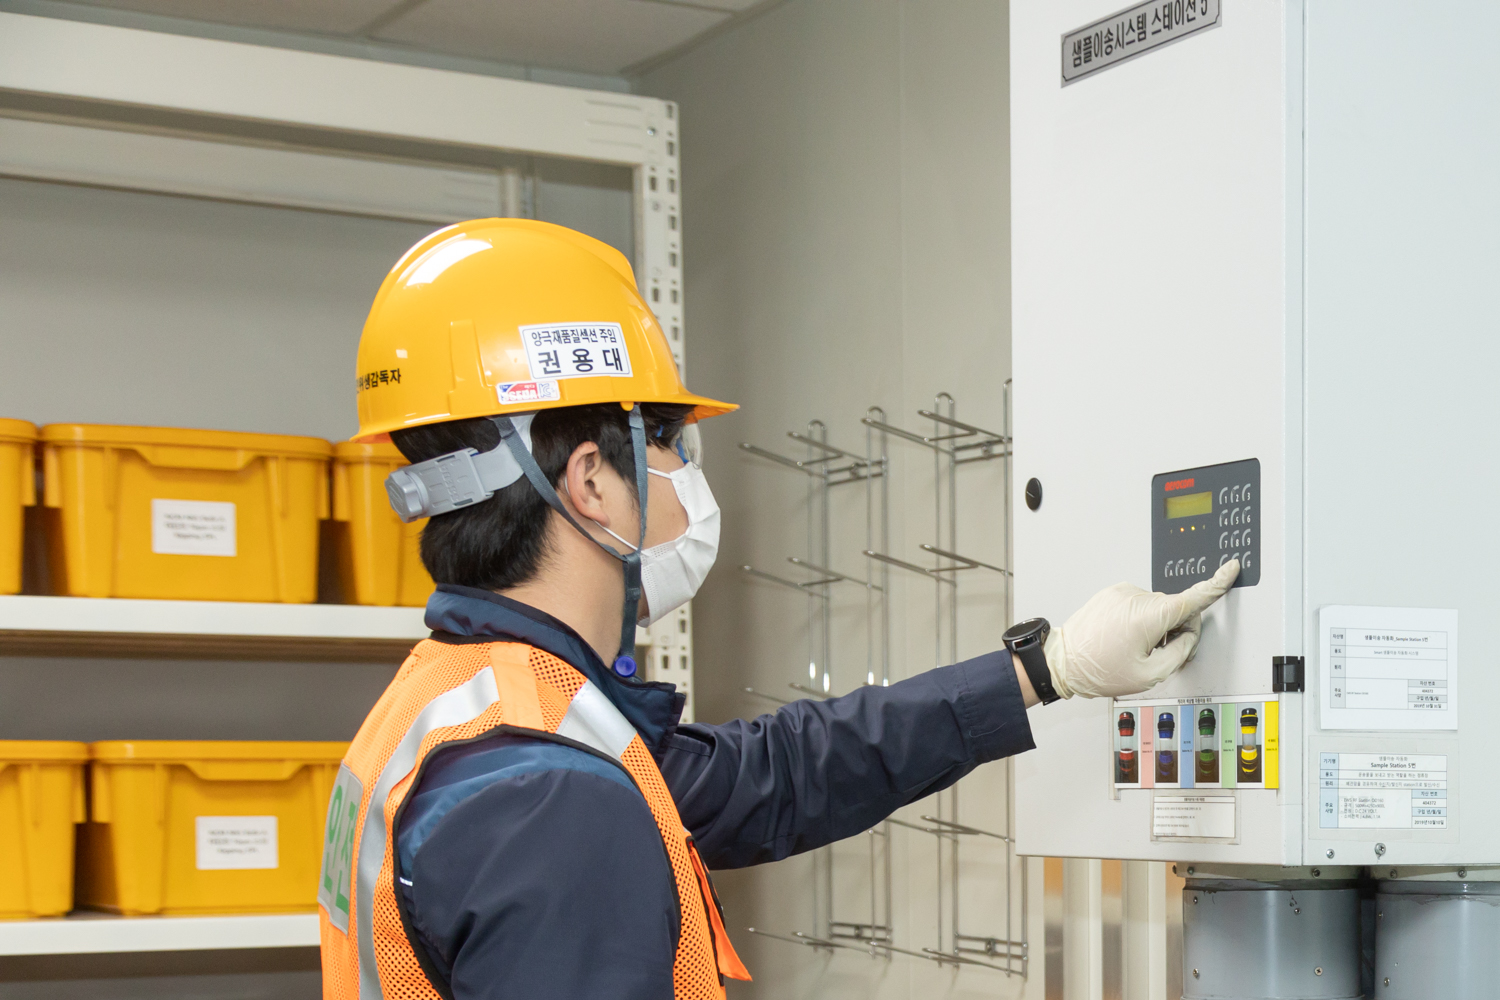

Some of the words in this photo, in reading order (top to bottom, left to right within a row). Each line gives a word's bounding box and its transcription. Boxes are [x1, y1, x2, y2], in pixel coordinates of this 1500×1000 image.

[1072, 13, 1147, 68] 샘플이송시스템
[1151, 0, 1197, 35] 스테이션
[532, 328, 598, 346] 양극재품질섹션
[599, 328, 617, 343] 주임
[1165, 478, 1194, 492] aerocom
